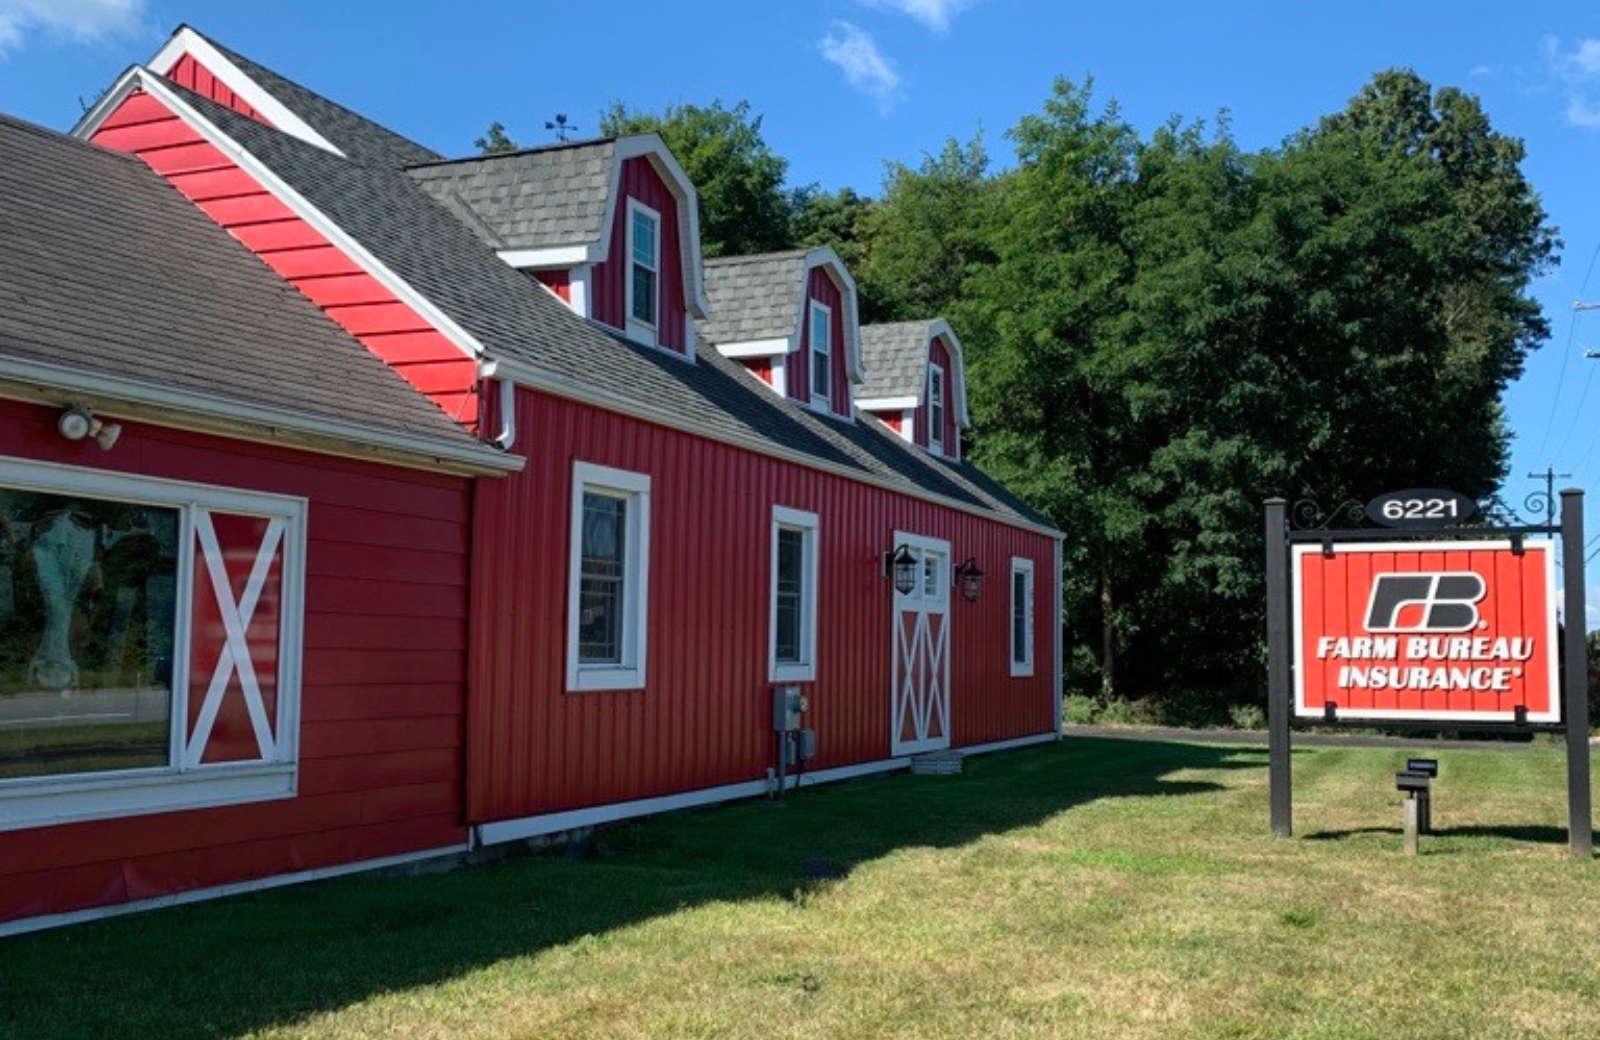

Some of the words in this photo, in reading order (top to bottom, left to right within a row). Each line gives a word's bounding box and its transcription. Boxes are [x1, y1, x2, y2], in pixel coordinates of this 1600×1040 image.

[1382, 498, 1459, 520] 6221
[1316, 635, 1400, 660] FARM
[1405, 635, 1533, 661] BUREAU
[1338, 666, 1513, 690] INSURANCE
